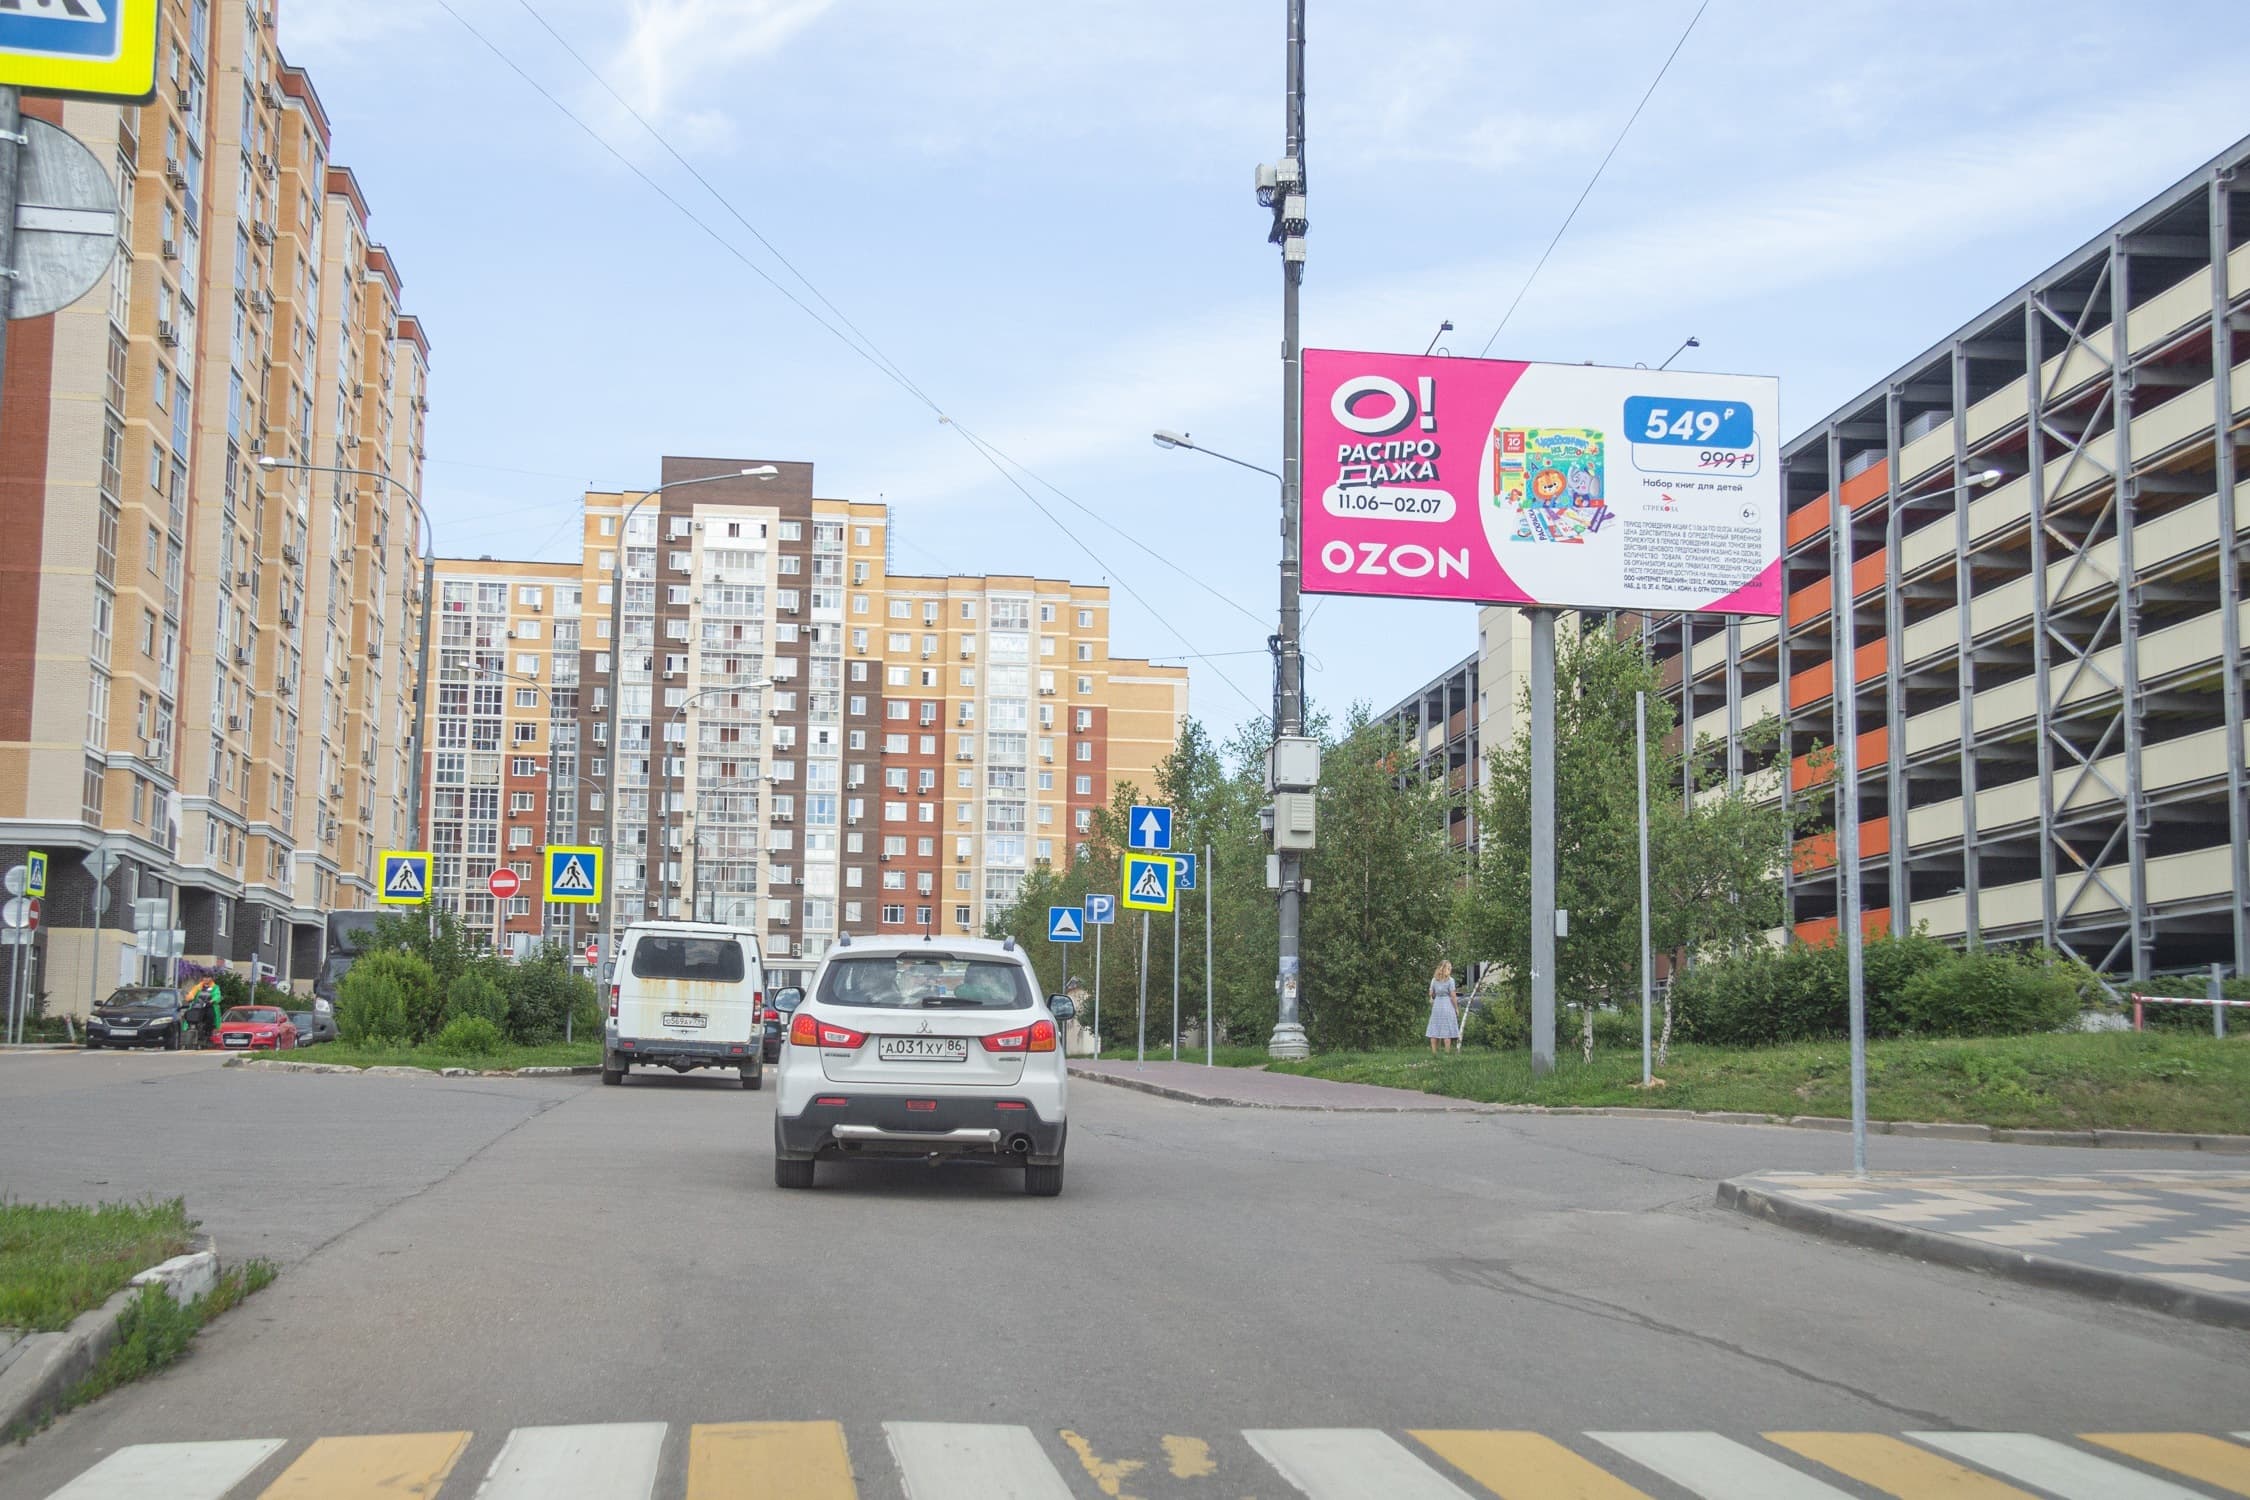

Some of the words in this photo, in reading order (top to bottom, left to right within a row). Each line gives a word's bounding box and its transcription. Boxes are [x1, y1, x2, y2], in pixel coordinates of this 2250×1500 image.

[1331, 375, 1436, 434] О!
[1645, 409, 1719, 441] 549
[1338, 439, 1440, 464] РАСПРО
[1700, 451, 1736, 469] 999
[1336, 461, 1437, 487] ДАЖА
[1643, 478, 1673, 489] Набор
[1717, 483, 1743, 491] детей
[1742, 509, 1757, 518] 6+
[1321, 540, 1470, 580] OZON
[1093, 898, 1109, 920] P
